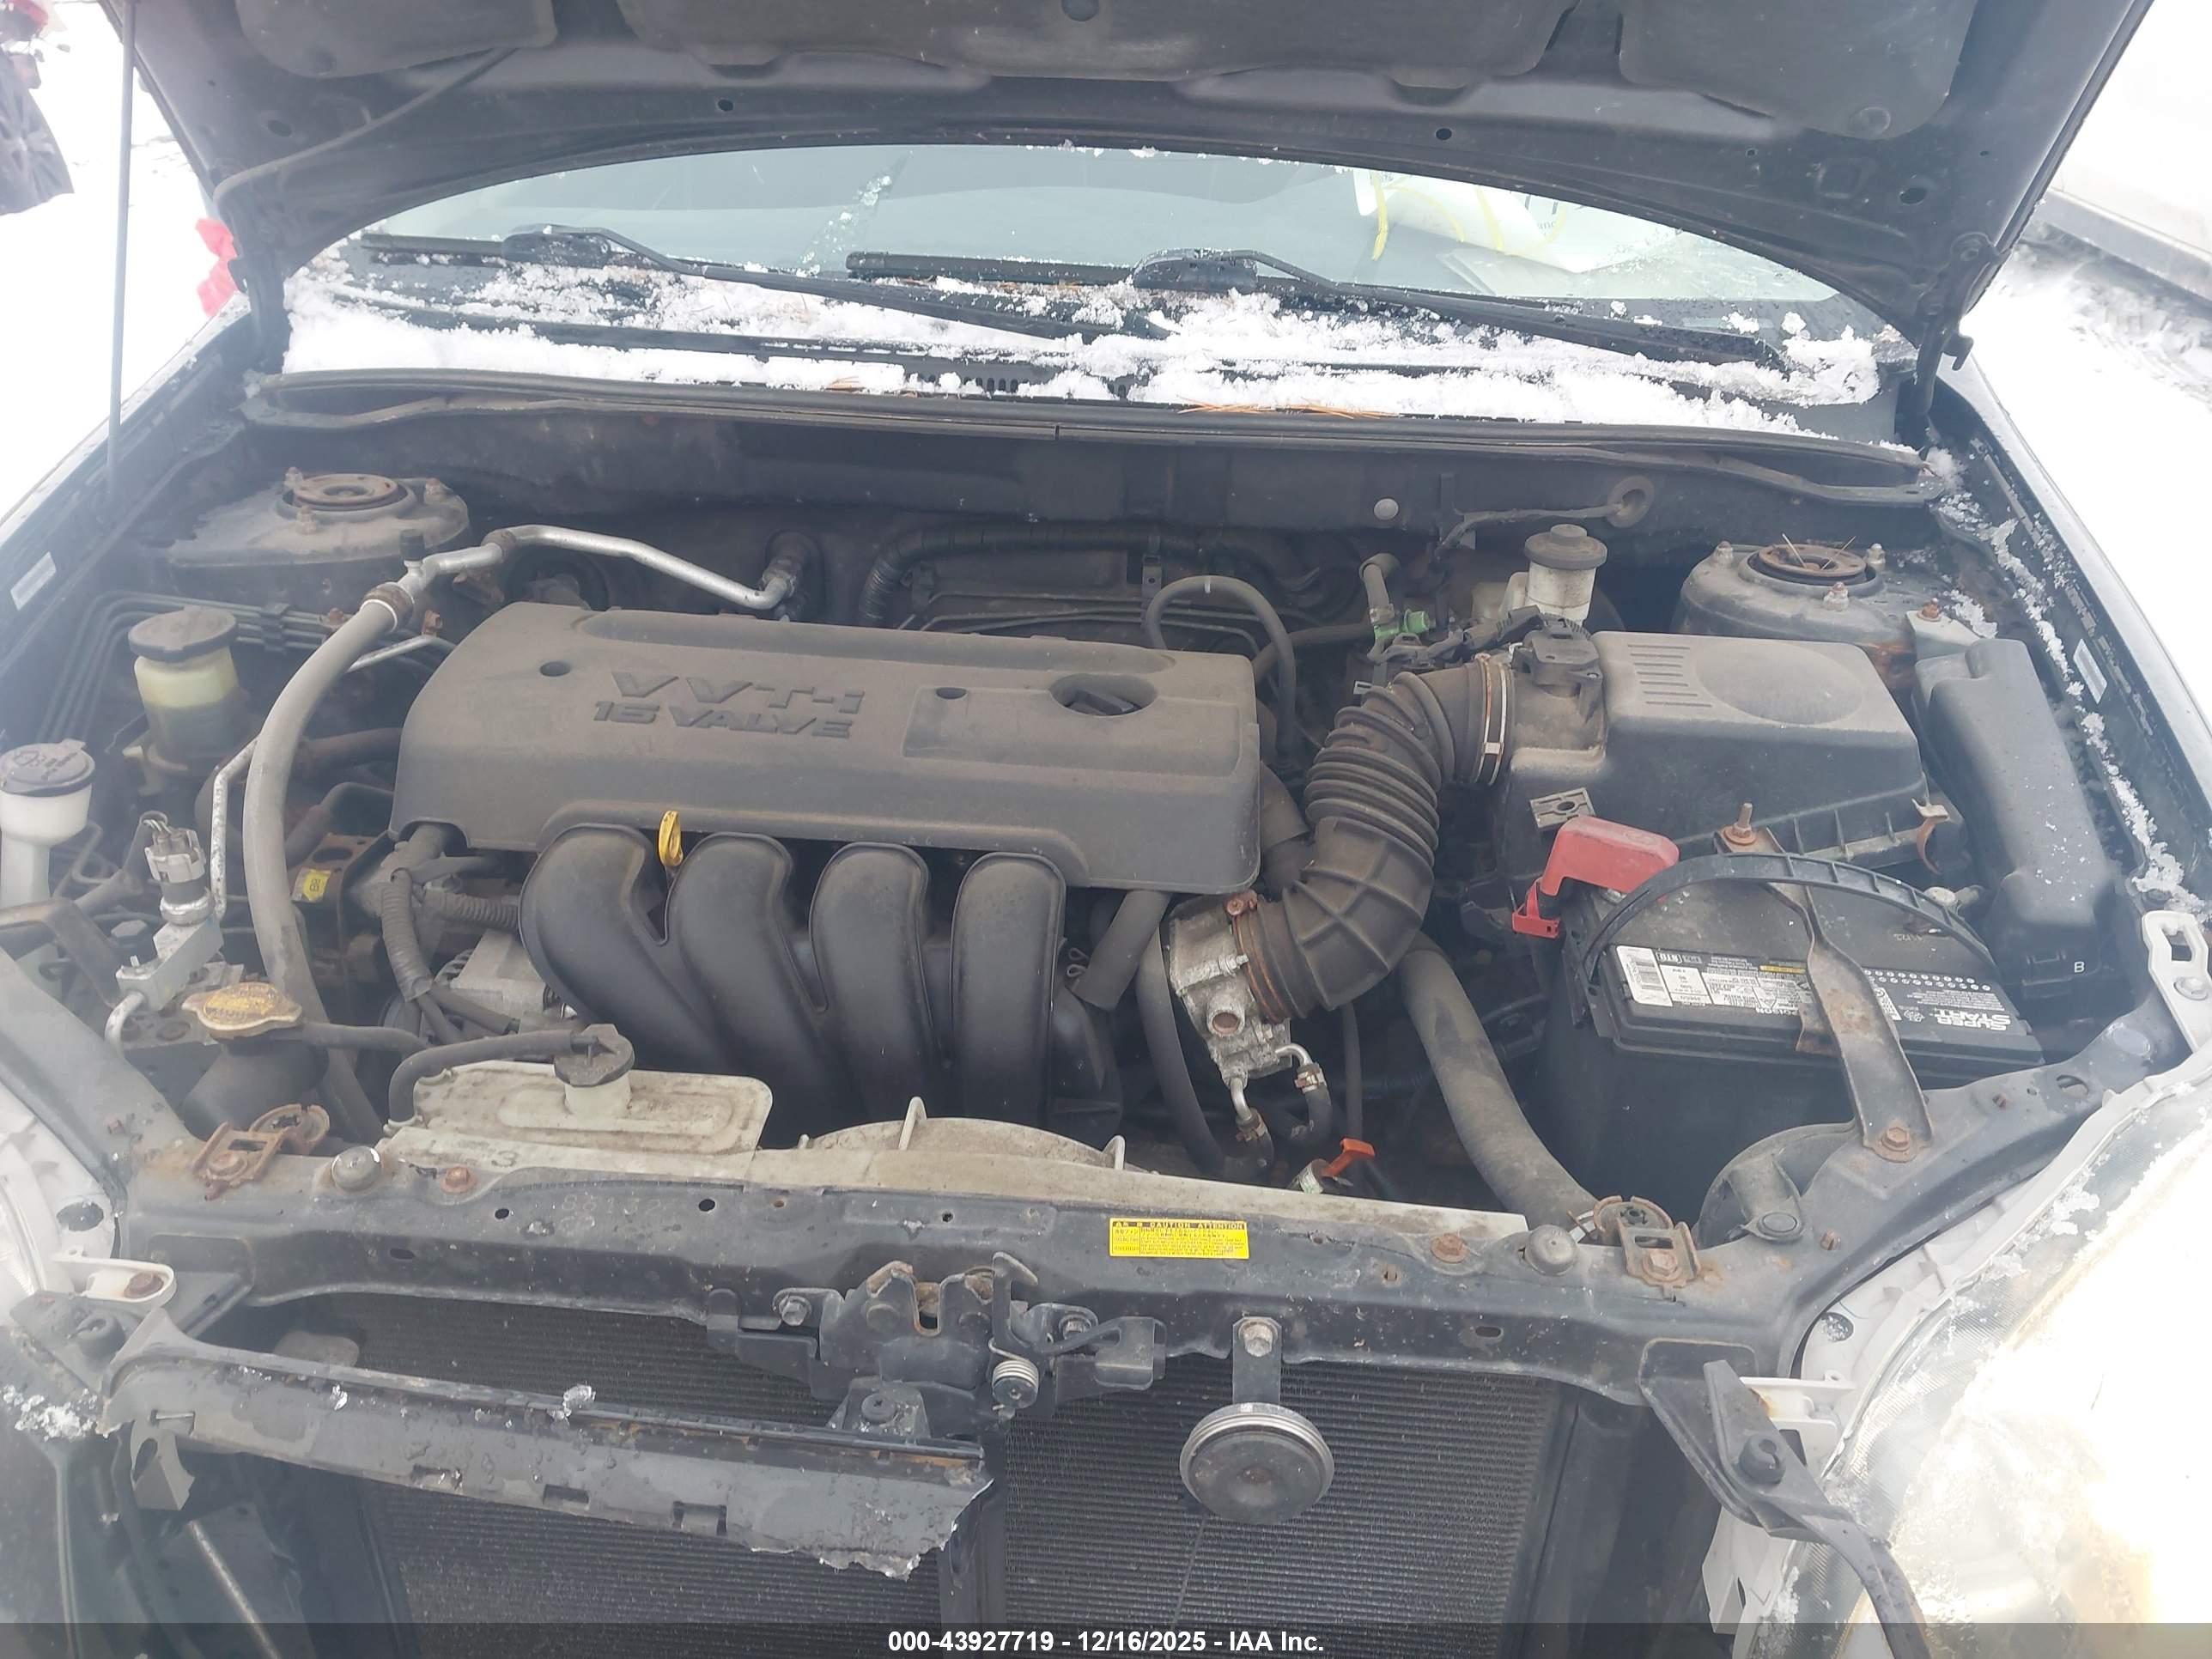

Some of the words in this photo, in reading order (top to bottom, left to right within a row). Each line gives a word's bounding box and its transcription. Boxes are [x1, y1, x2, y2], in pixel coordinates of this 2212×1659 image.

[592, 700, 660, 725] 16
[669, 706, 853, 738] VALVE
[2074, 961, 2085, 973] B
[1935, 1007, 2011, 1025] START
[1936, 1015, 2007, 1030] SUPER
